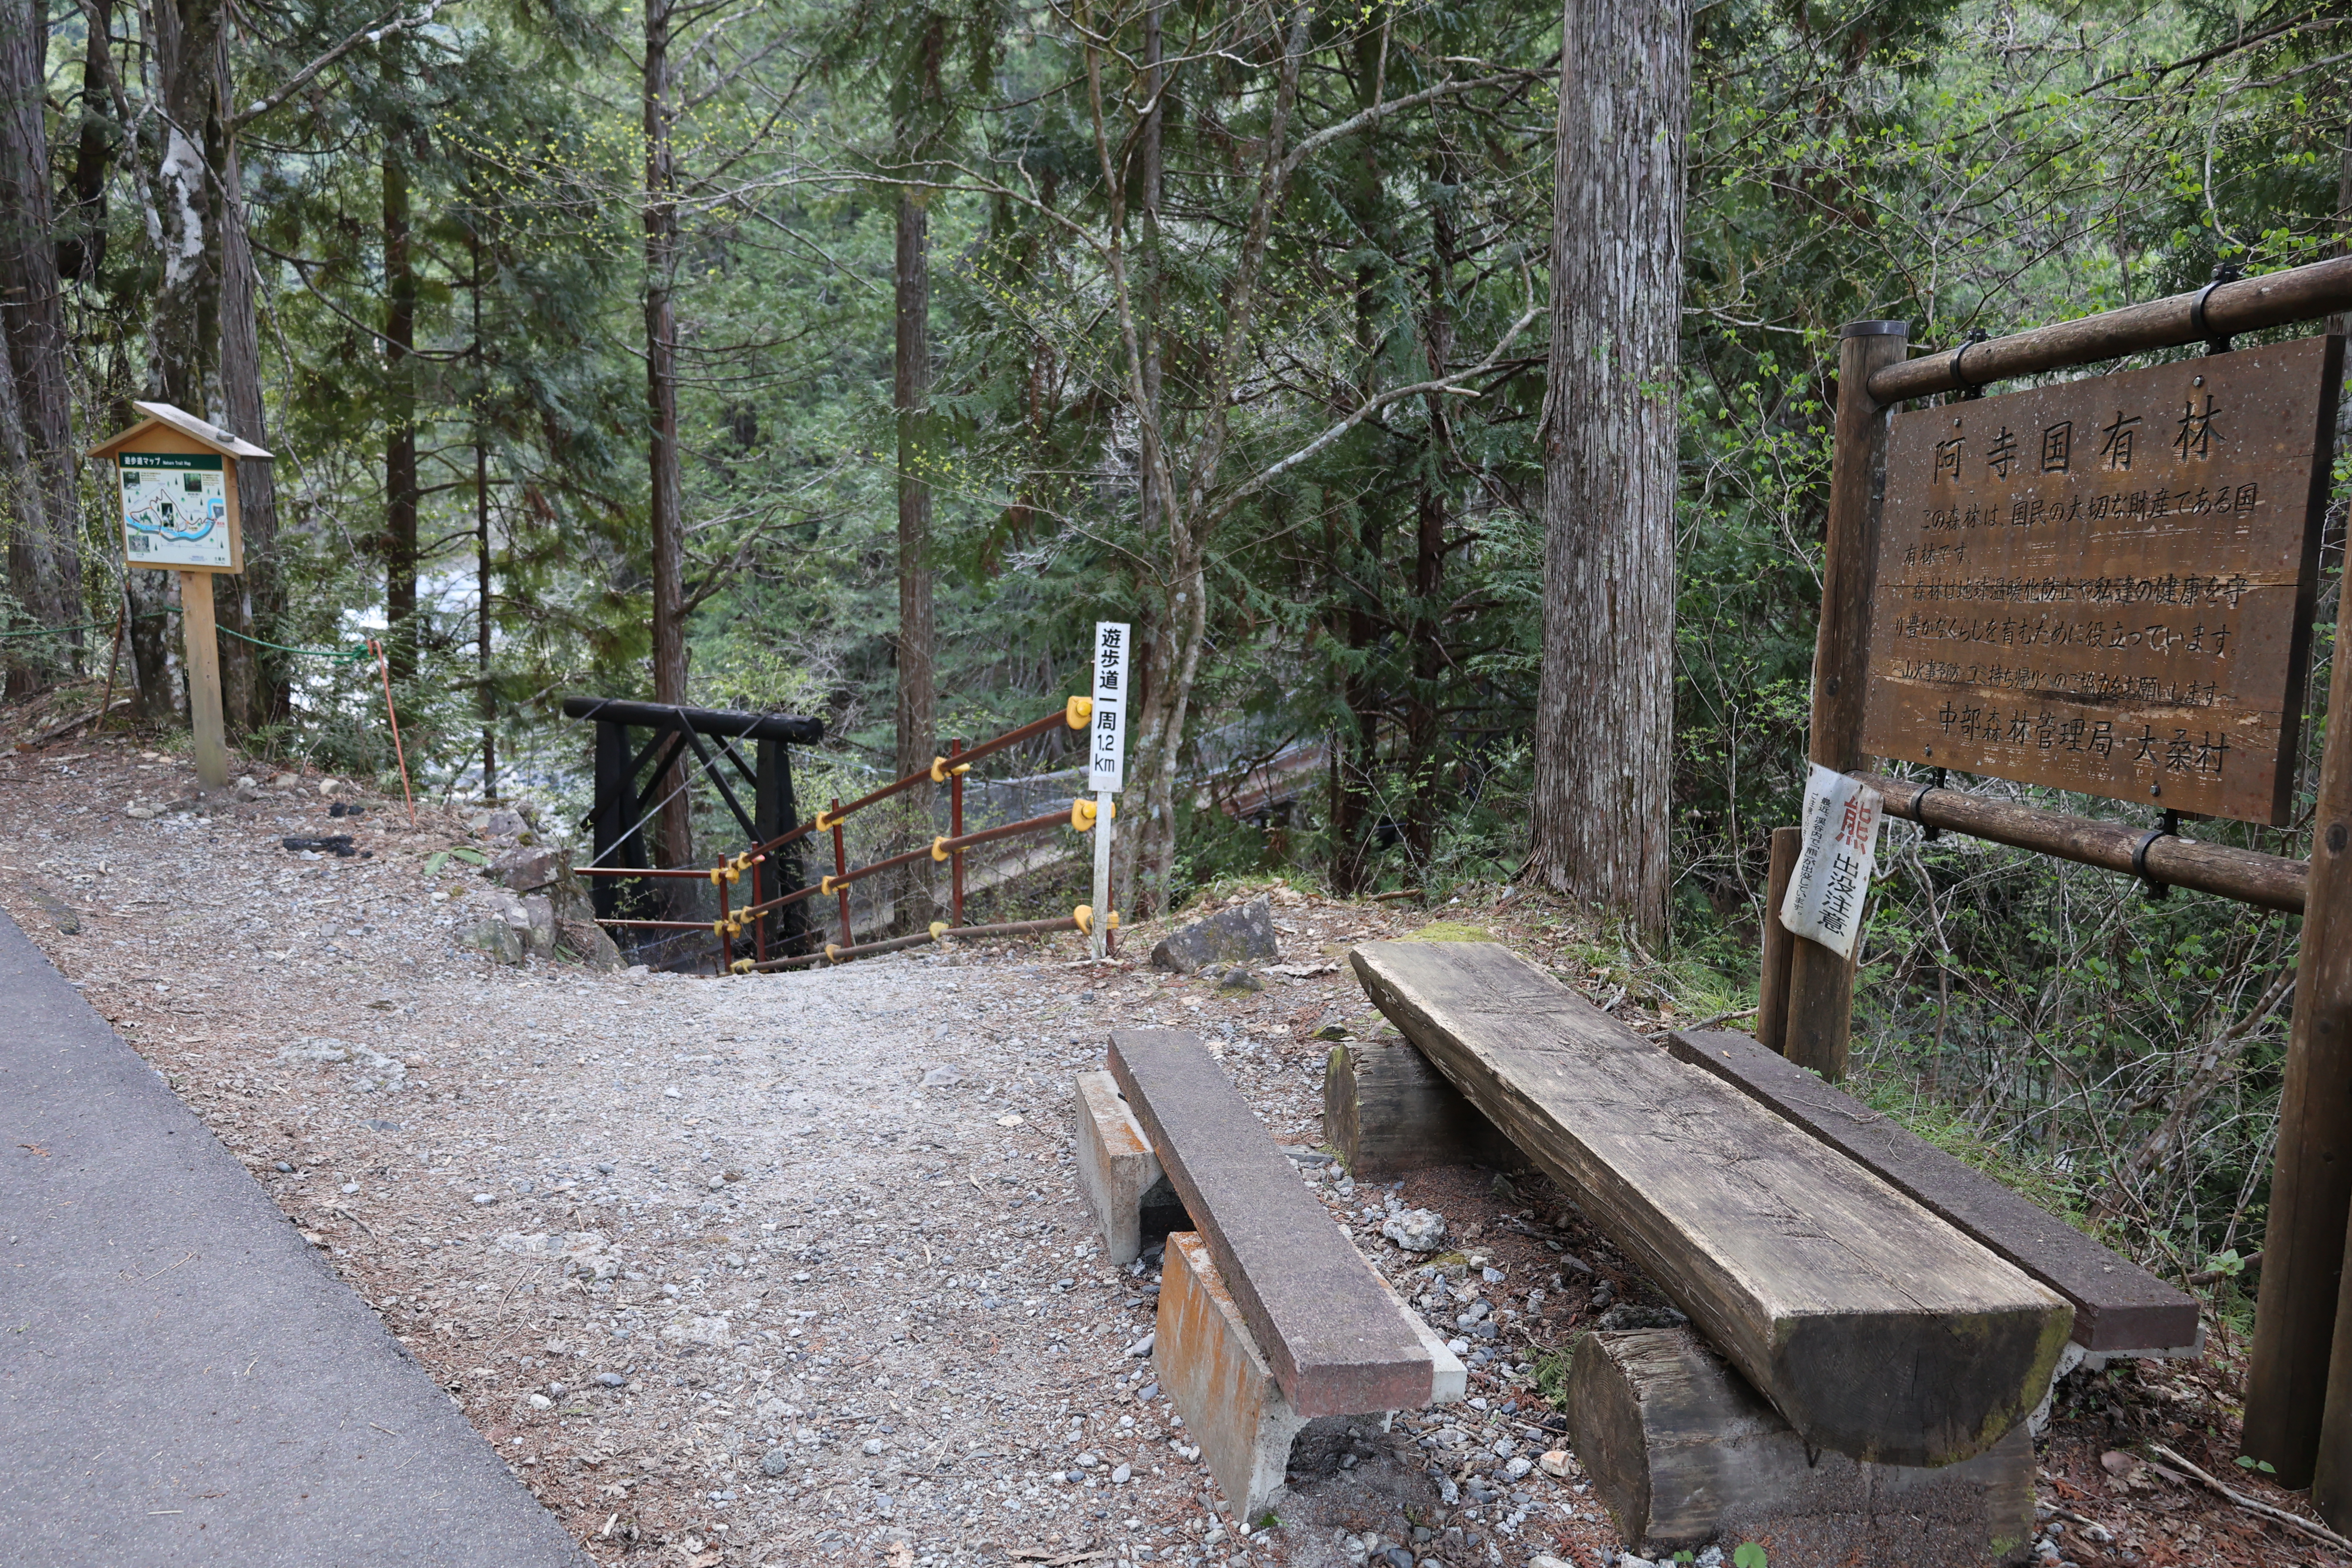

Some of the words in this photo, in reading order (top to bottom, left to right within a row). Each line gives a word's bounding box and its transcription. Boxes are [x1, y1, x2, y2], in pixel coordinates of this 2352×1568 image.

[124, 456, 161, 466] 遊歩道マップ
[1933, 395, 2226, 484] 阿寺国有林
[1920, 482, 2257, 531] この森林は、国民の大切な財産である国
[1904, 542, 1972, 567] 有林です。
[1913, 573, 2248, 603] 森林は地球温暖化防止や私達の健康を守
[1896, 611, 2236, 655] り豊かなくらしを育むために役立っています。
[1097, 628, 1122, 731] 遊歩道一周
[1095, 753, 1115, 772] km
[1097, 734, 1115, 751] 1.2
[1835, 795, 1872, 855] 熊
[1817, 852, 1859, 937] 出没注意
